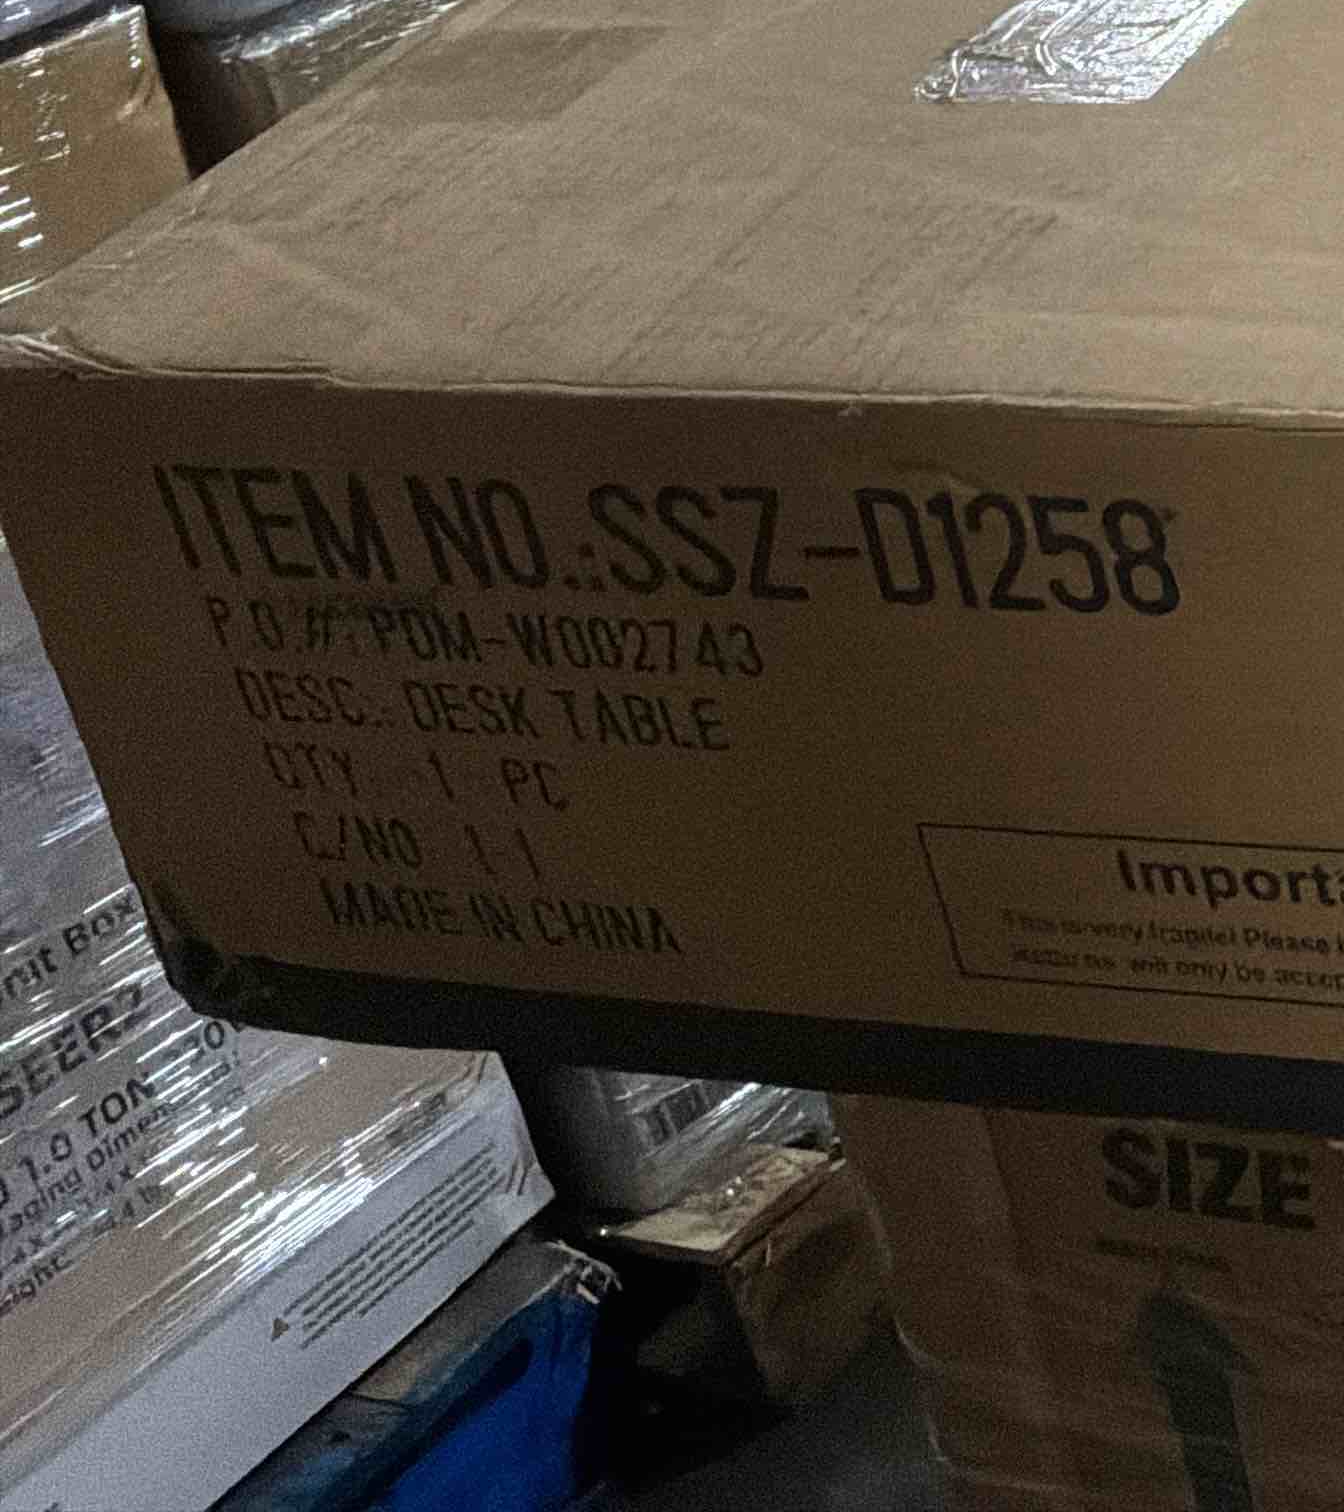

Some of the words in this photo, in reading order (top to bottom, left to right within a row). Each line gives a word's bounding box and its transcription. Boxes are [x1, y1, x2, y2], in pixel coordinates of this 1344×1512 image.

[152, 462, 400, 585] ITEM
[403, 680, 542, 739] DESK
[549, 688, 731, 752] TABLE
[62, 896, 138, 957] Box
[319, 878, 463, 937] MADE
[469, 891, 526, 945] IN
[531, 895, 683, 955] CHINA
[1243, 925, 1329, 954] Please
[1235, 961, 1265, 985] be
[19, 1130, 74, 1184] 1.0
[1099, 1124, 1318, 1234] SIZE
